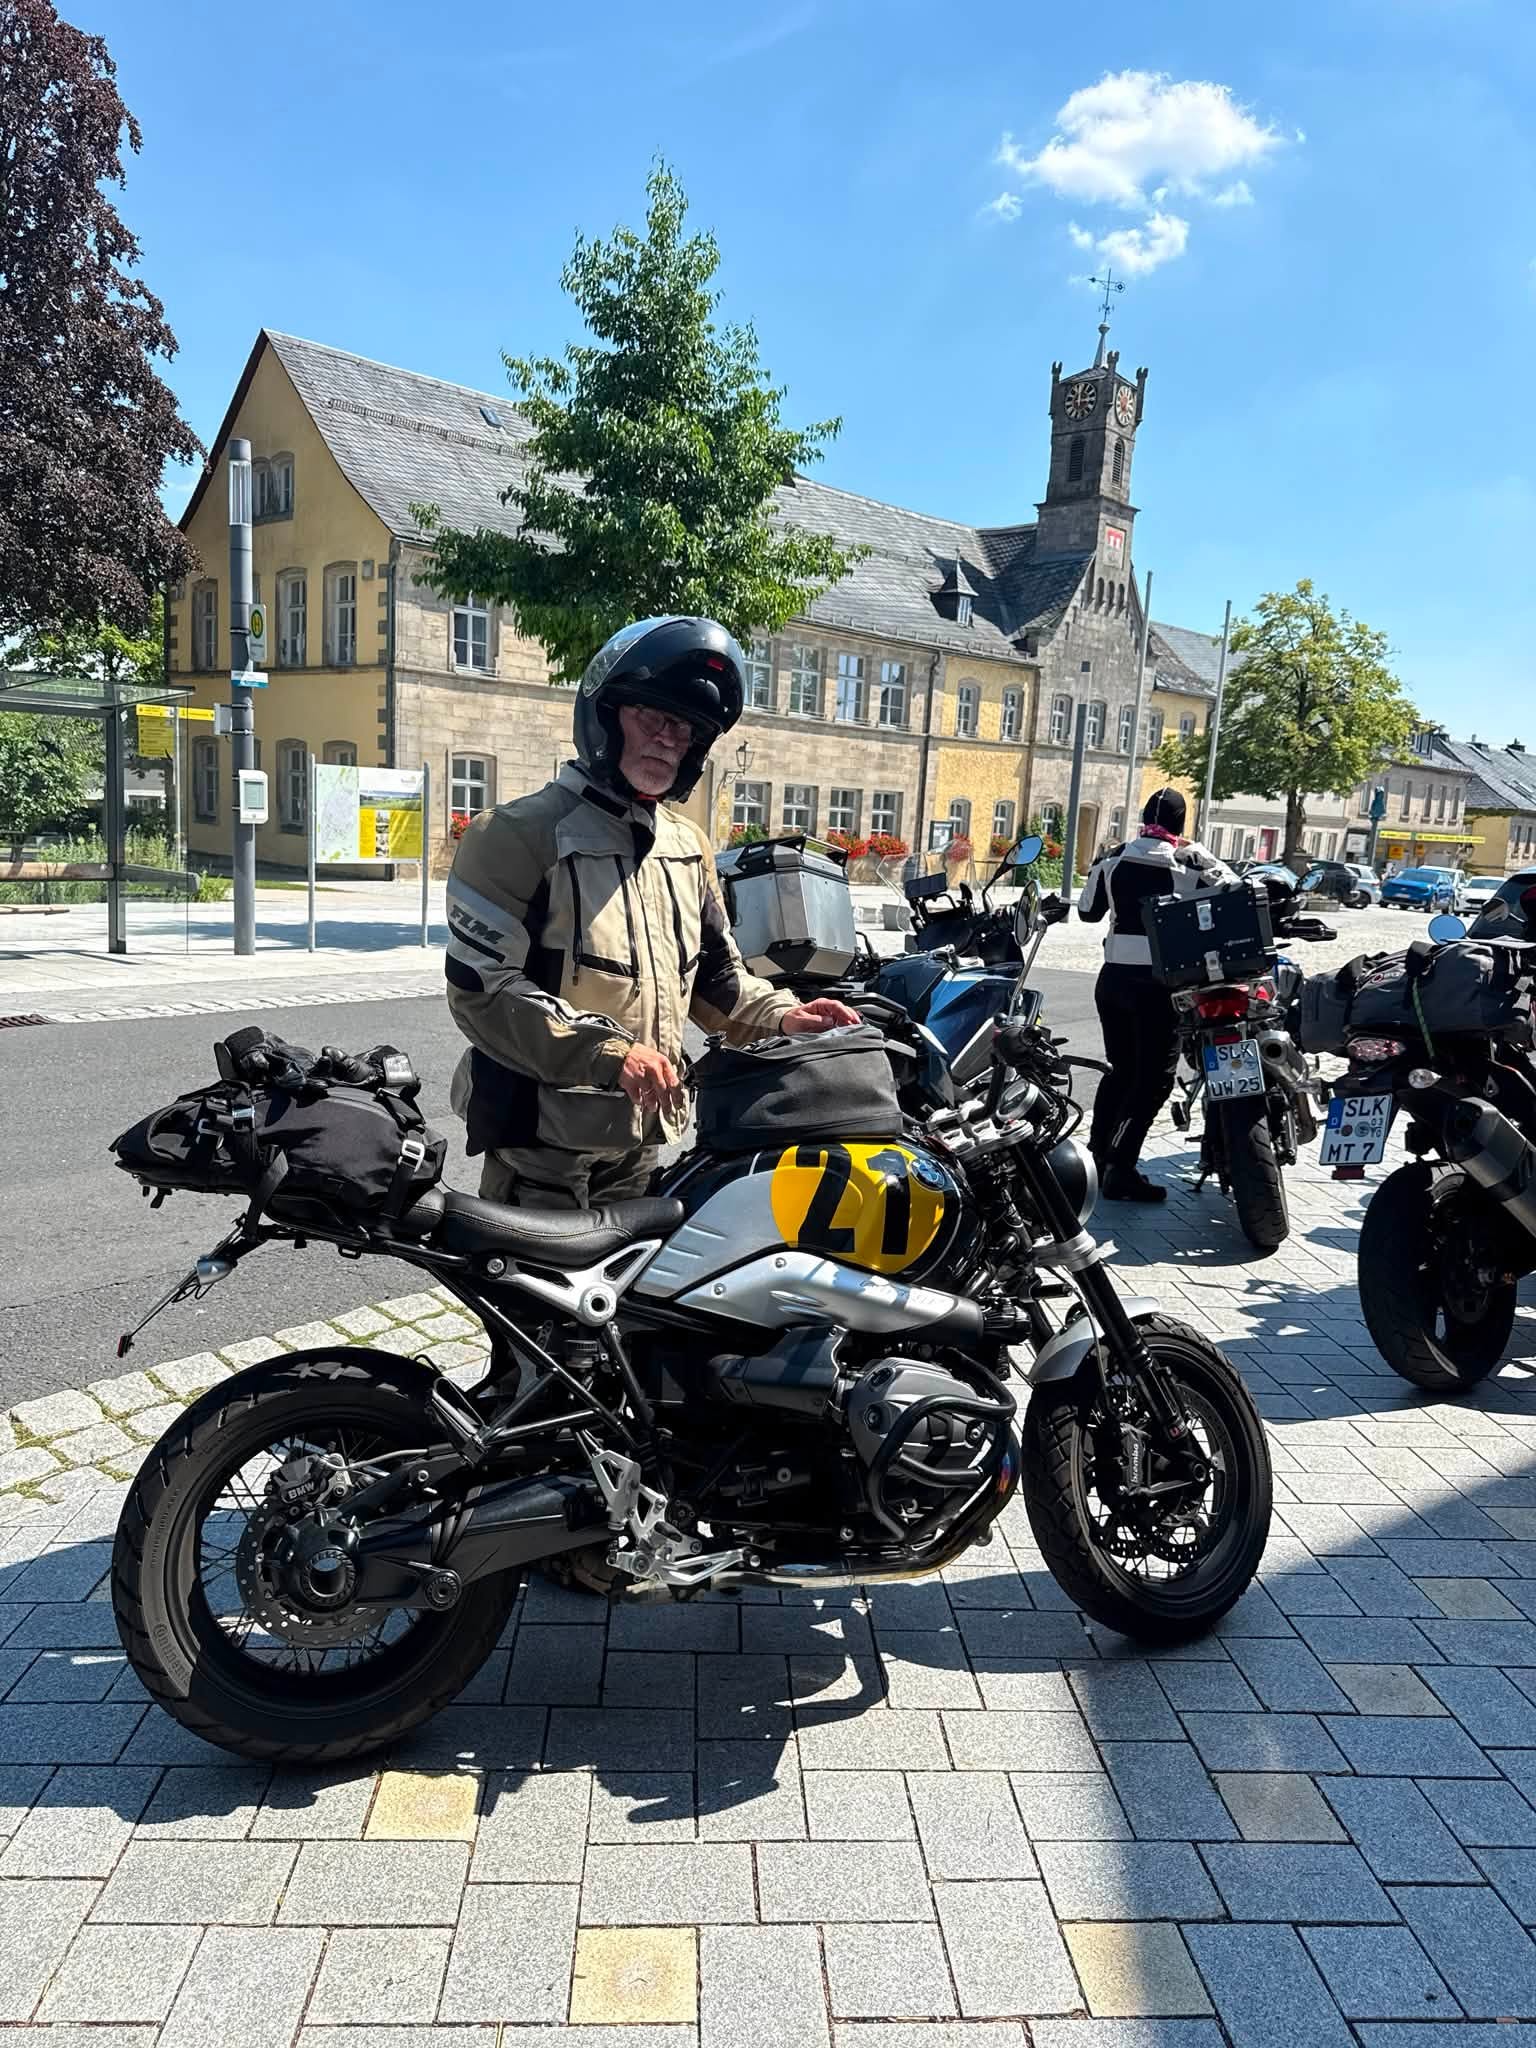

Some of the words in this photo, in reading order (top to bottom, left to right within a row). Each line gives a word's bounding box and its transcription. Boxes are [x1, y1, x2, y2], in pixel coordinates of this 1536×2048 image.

[450, 904, 505, 945] FLM
[1218, 1043, 1254, 1061] SLK
[1238, 1076, 1260, 1094] 25
[1345, 1097, 1387, 1117] SLK
[1327, 1143, 1356, 1162] MT
[1362, 1142, 1376, 1161] 7
[796, 1143, 908, 1255] 21
[1131, 1443, 1139, 1484] brembo
[288, 1481, 315, 1500] BMW
